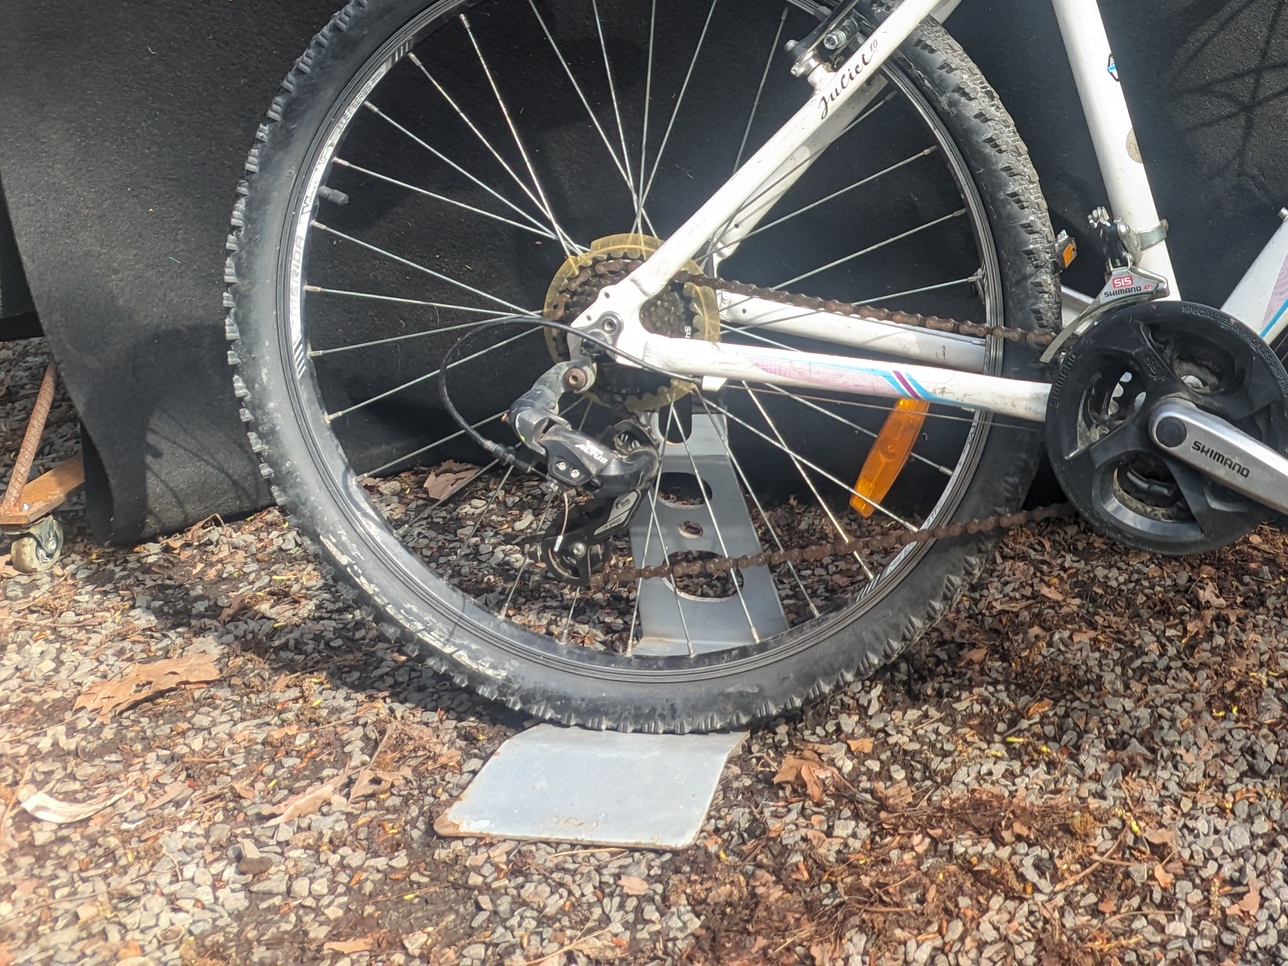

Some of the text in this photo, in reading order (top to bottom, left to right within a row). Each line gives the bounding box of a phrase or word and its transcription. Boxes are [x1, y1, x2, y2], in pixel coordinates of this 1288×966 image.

[818, 52, 872, 120] Juliet
[1114, 277, 1132, 287] SIS
[1104, 285, 1141, 297] SHIMANO
[1181, 305, 1217, 320] SPECIAL
[1192, 440, 1251, 479] SHIMANO
